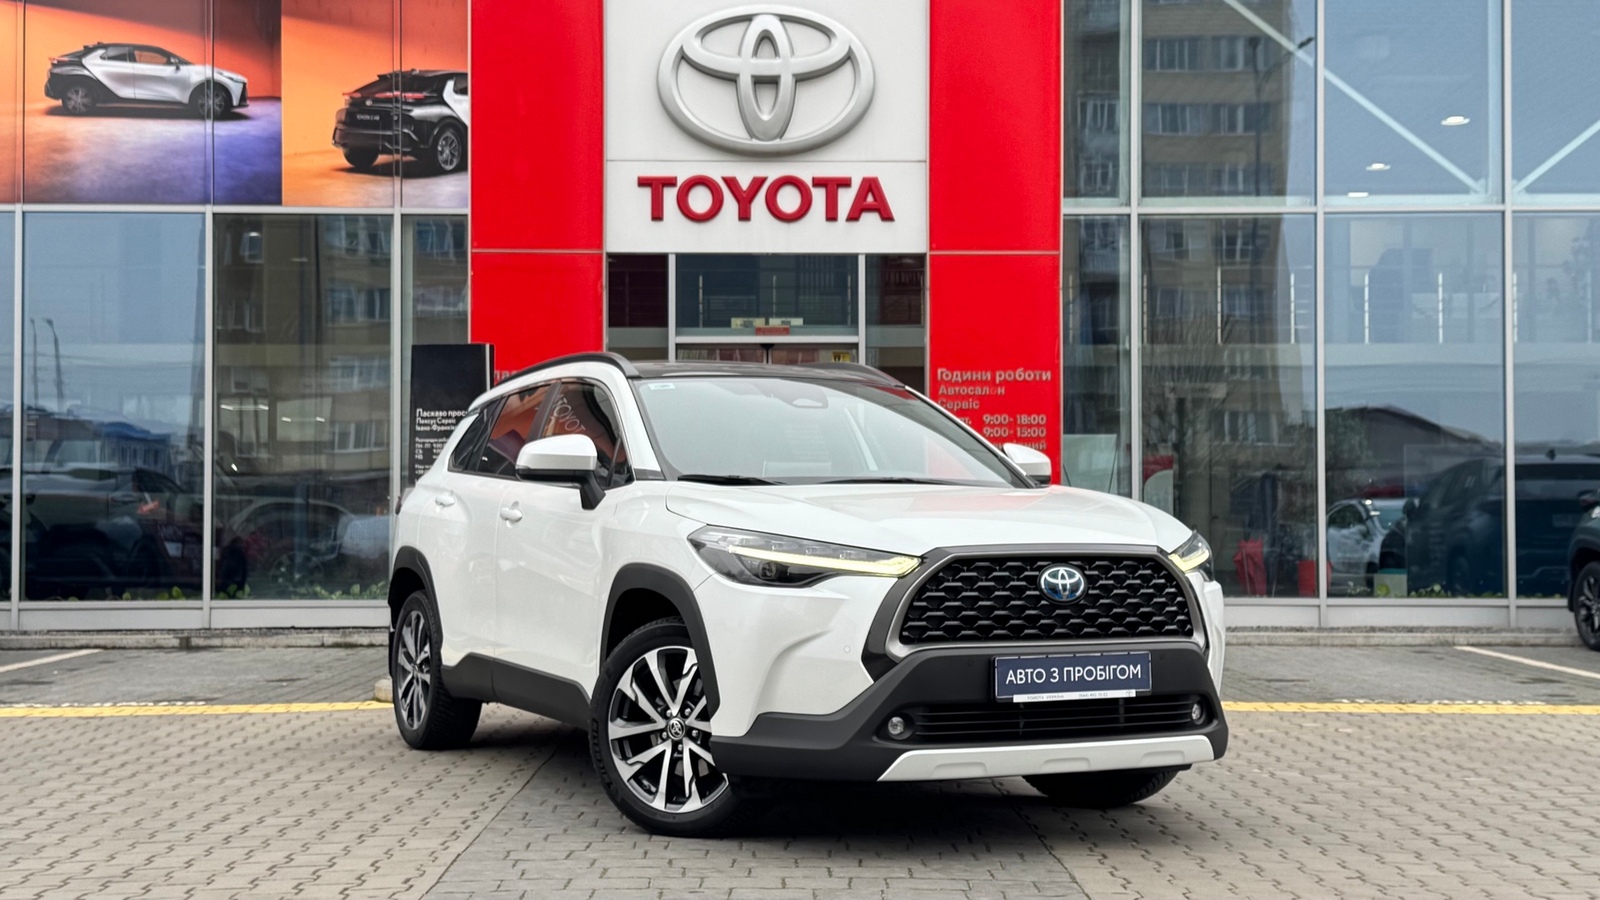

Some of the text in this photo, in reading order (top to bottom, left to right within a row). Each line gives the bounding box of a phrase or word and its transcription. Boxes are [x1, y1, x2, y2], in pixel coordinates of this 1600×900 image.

[637, 174, 895, 223] TOYOTA
[937, 367, 1051, 384] Години роботи
[938, 398, 979, 411] Сервіс
[448, 410, 468, 418] прос
[983, 414, 1009, 425] 9:00
[1016, 414, 1046, 425] 18:00
[983, 427, 1009, 438] 9:00
[1016, 427, 1046, 438] 15:00
[1005, 668, 1046, 685] АВТО
[1062, 664, 1142, 682] ПРОБІГОМ
